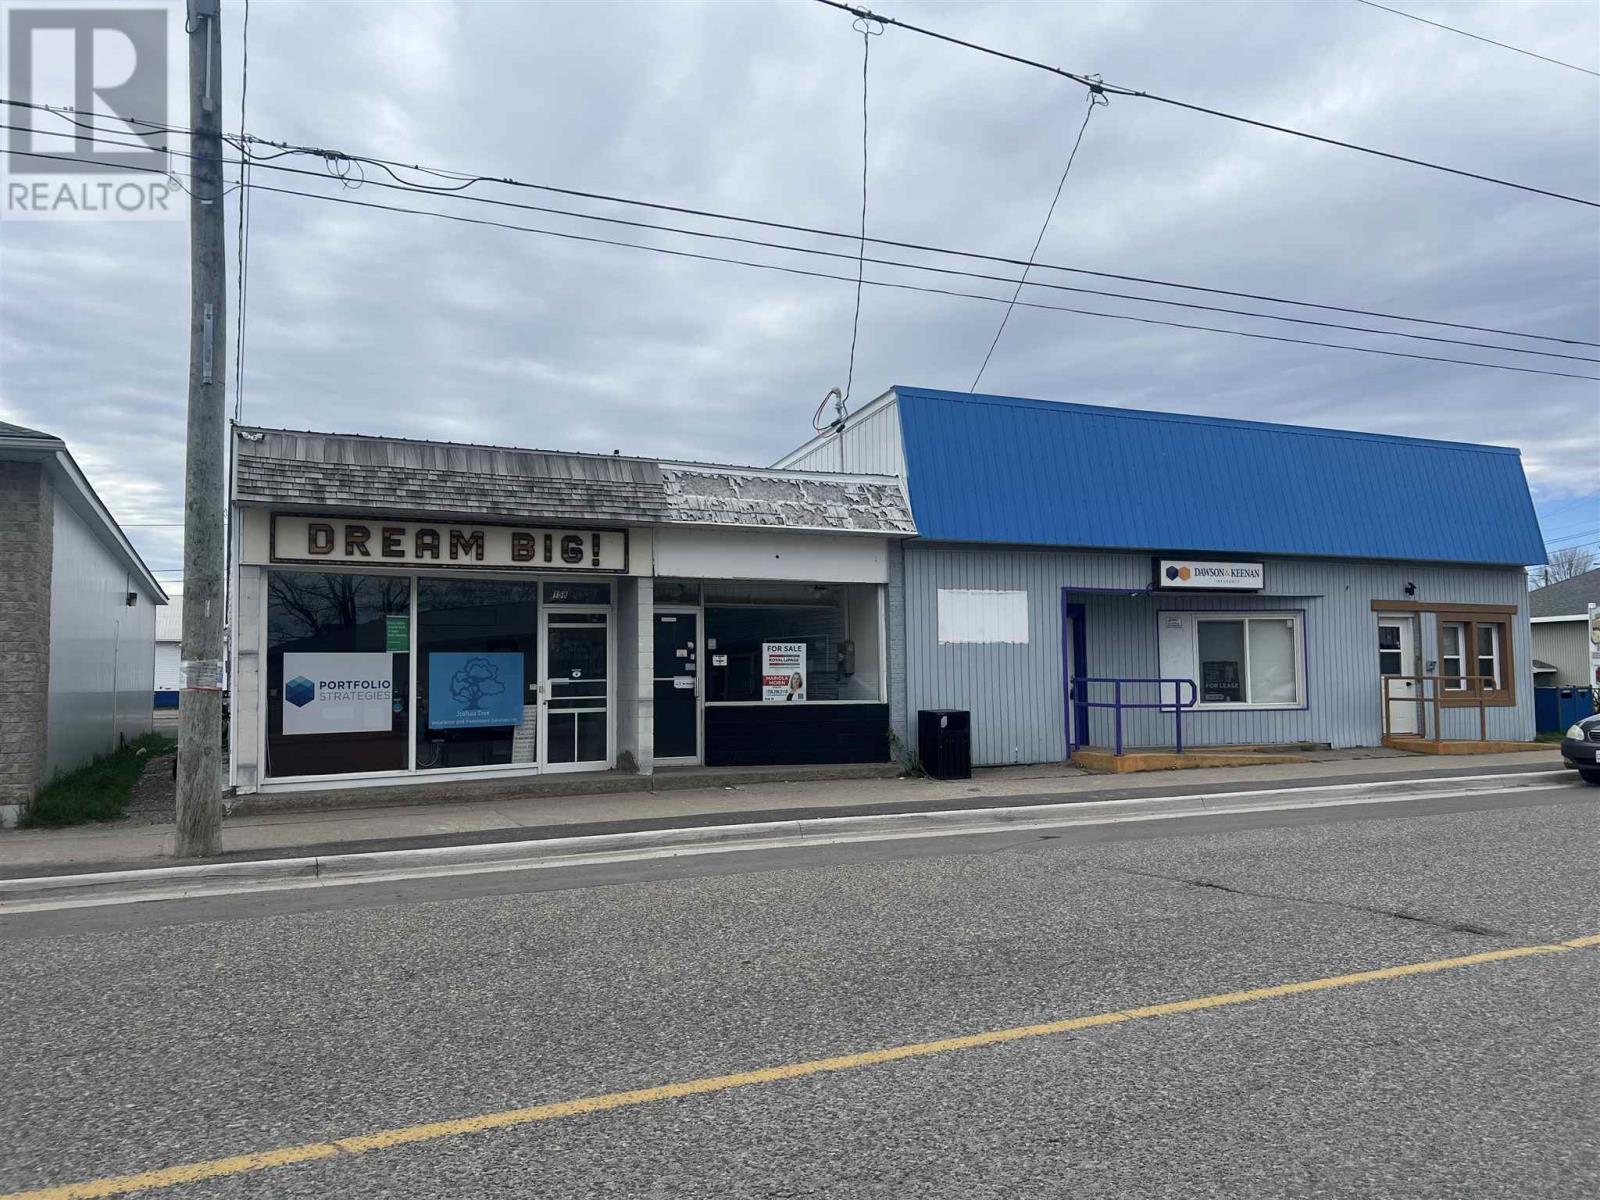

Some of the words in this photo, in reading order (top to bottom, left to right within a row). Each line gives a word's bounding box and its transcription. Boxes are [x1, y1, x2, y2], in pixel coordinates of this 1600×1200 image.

[308, 523, 484, 561] DREAM
[511, 531, 600, 567] BIG!
[319, 680, 391, 690] PORTFOLIO
[320, 691, 391, 701] STRATEGIES
